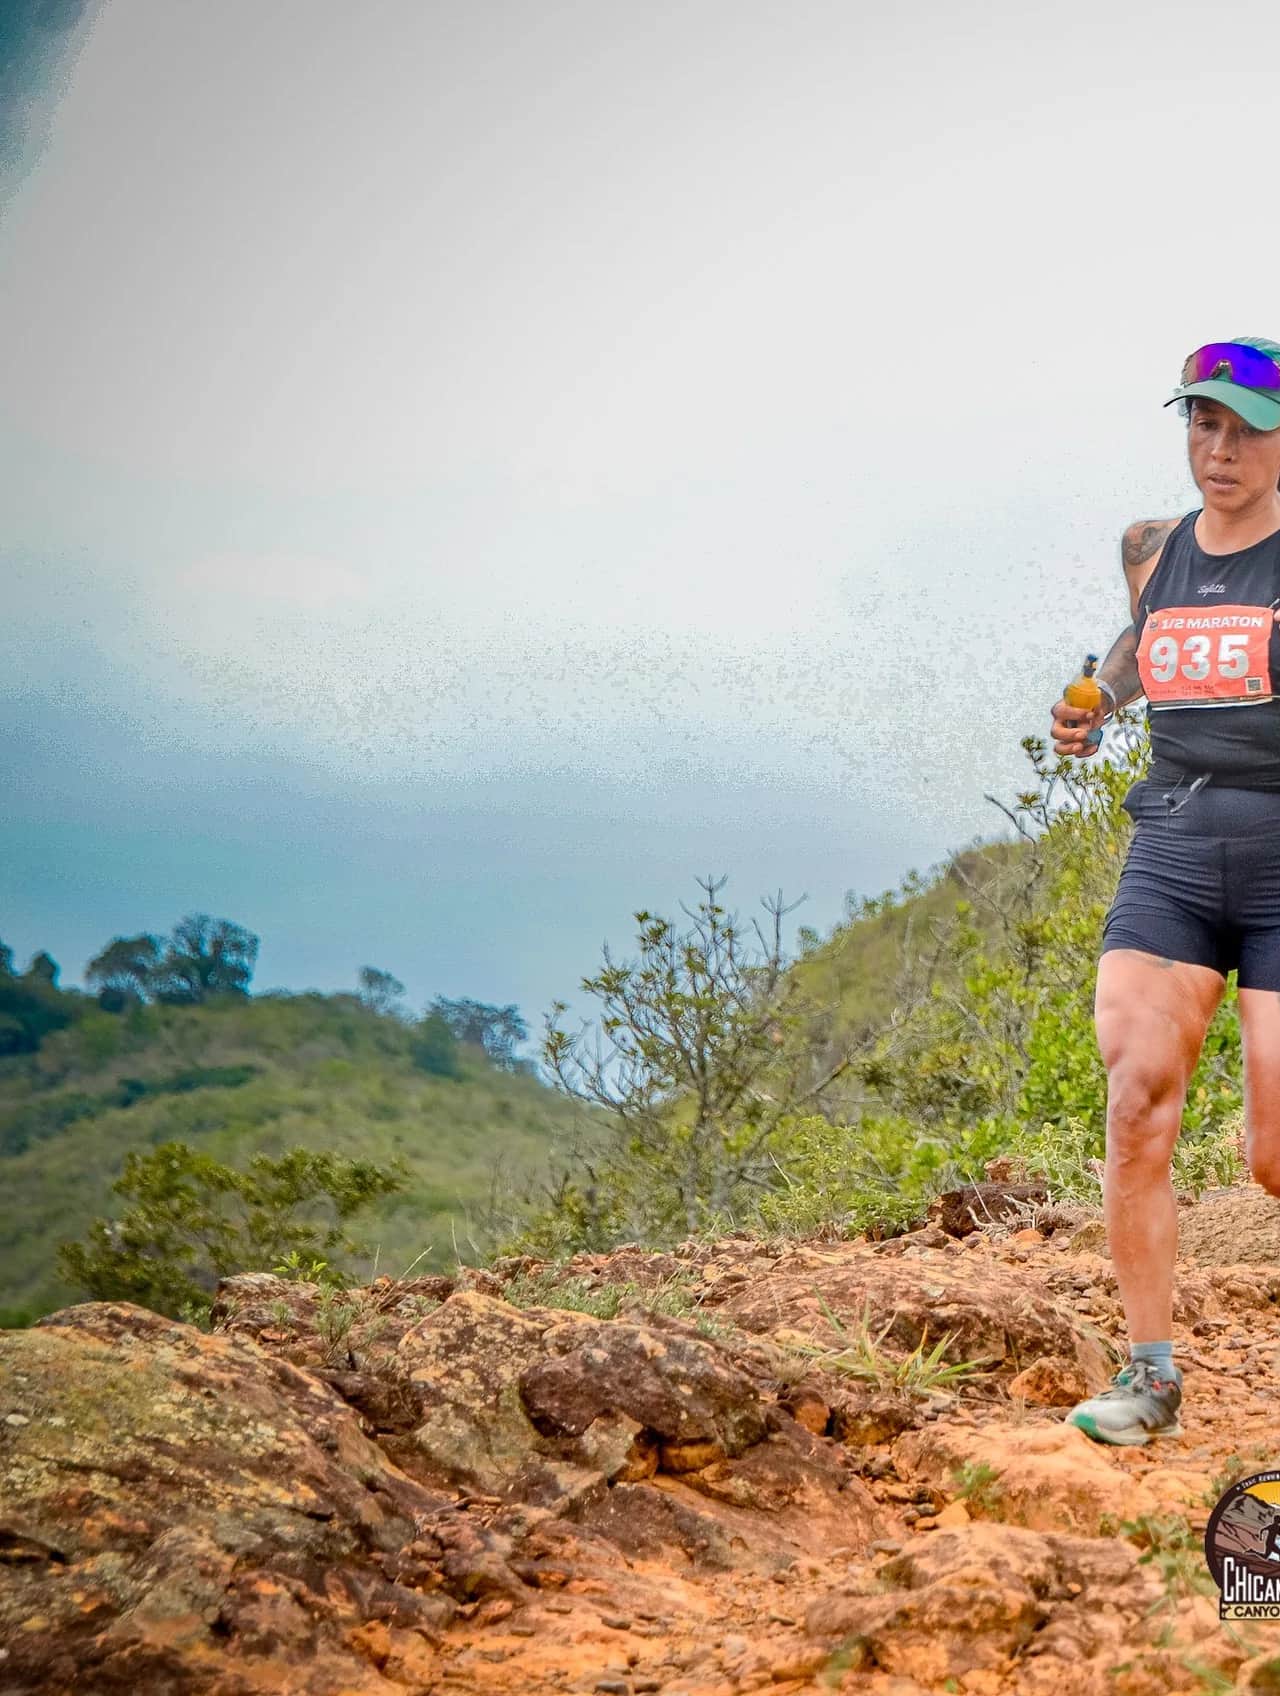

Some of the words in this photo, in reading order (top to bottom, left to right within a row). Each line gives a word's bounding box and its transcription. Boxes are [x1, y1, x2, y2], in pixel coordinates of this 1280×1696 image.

[1161, 617, 1184, 630] 1/2
[1186, 616, 1265, 629] MARATON
[1149, 634, 1249, 682] 935
